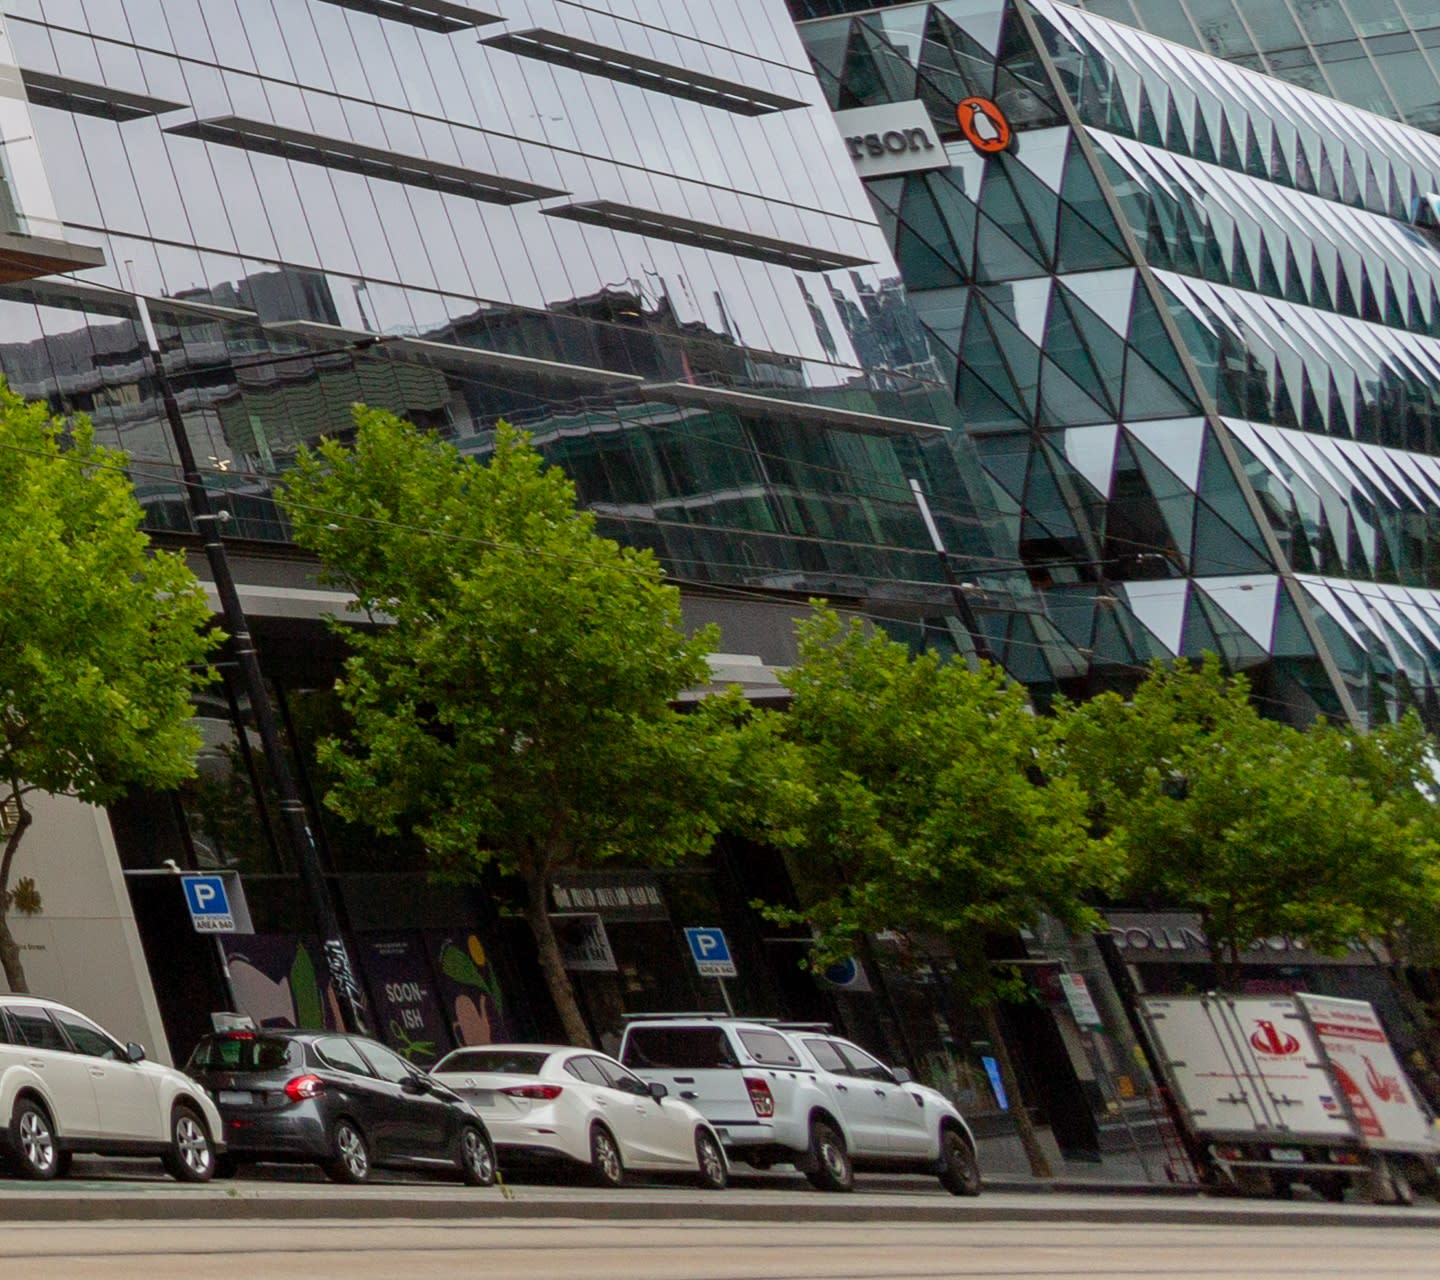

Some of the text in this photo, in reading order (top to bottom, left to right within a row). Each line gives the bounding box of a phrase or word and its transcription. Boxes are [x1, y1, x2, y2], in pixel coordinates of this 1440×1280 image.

[194, 884, 216, 910] P
[196, 920, 218, 929] AREA
[697, 935, 717, 957] P
[385, 981, 428, 1004] SOON-
[400, 1008, 424, 1029] ISH
